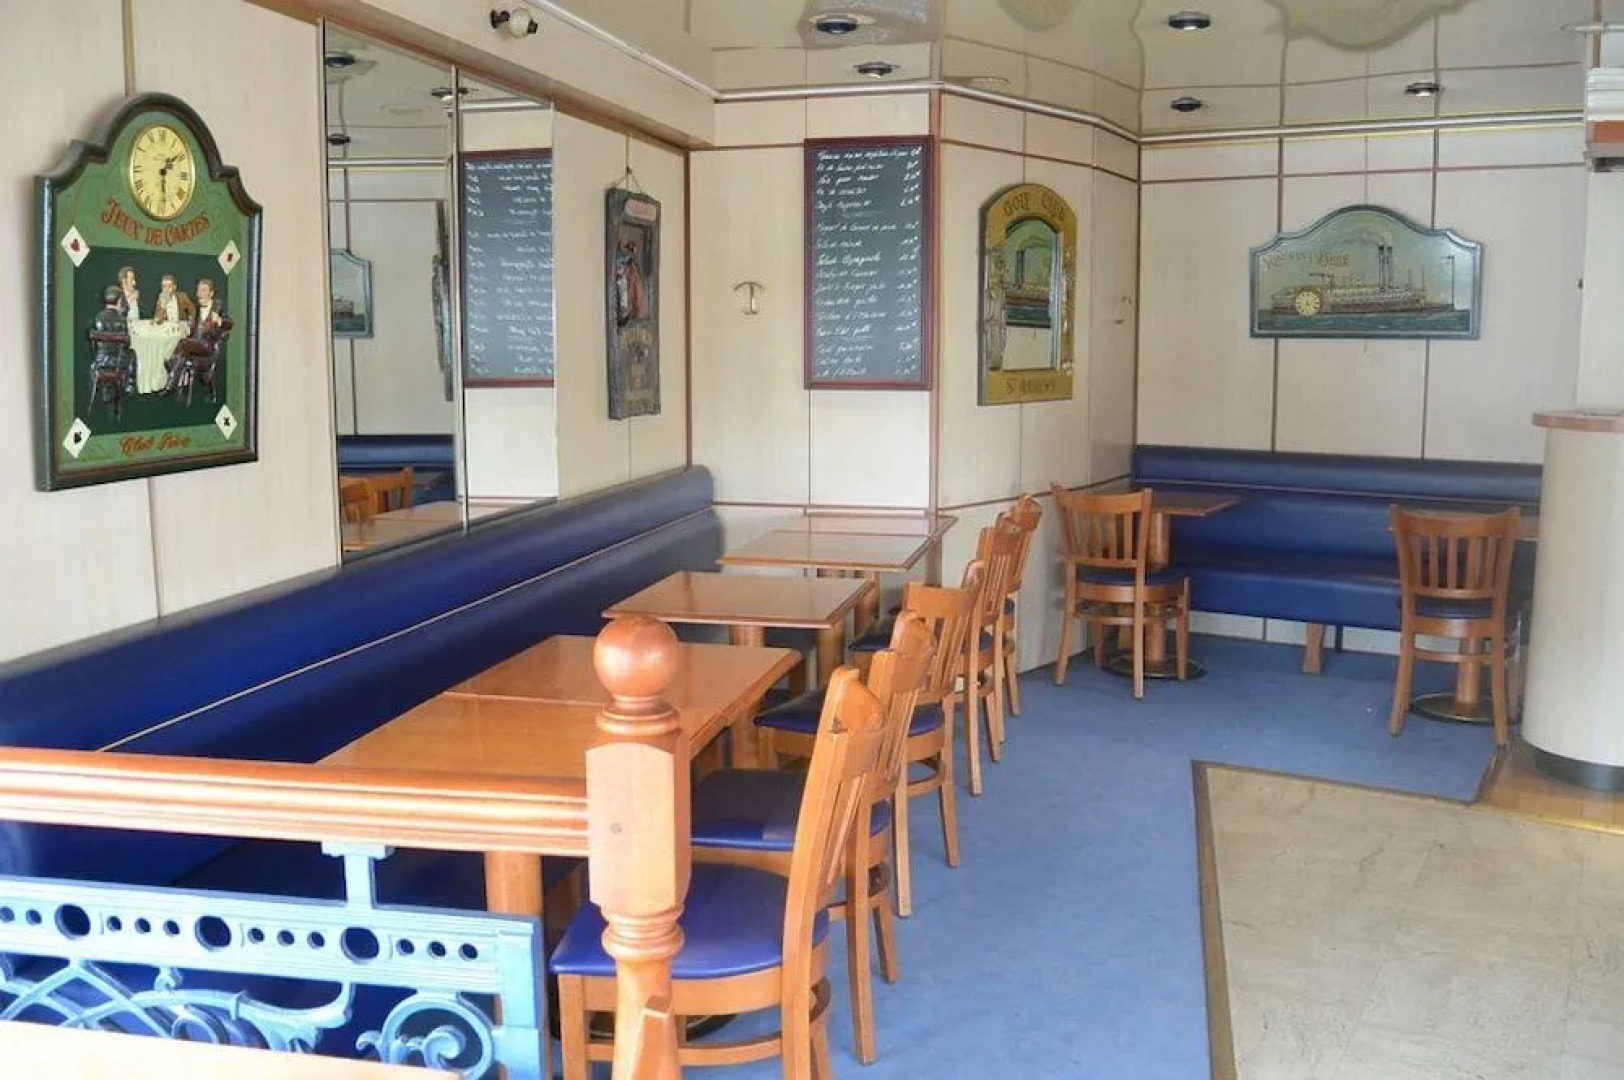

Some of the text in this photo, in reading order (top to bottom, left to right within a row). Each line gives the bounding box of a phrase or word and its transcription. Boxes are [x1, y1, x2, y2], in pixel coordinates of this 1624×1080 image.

[101, 196, 210, 247] JEUX DE CARTES
